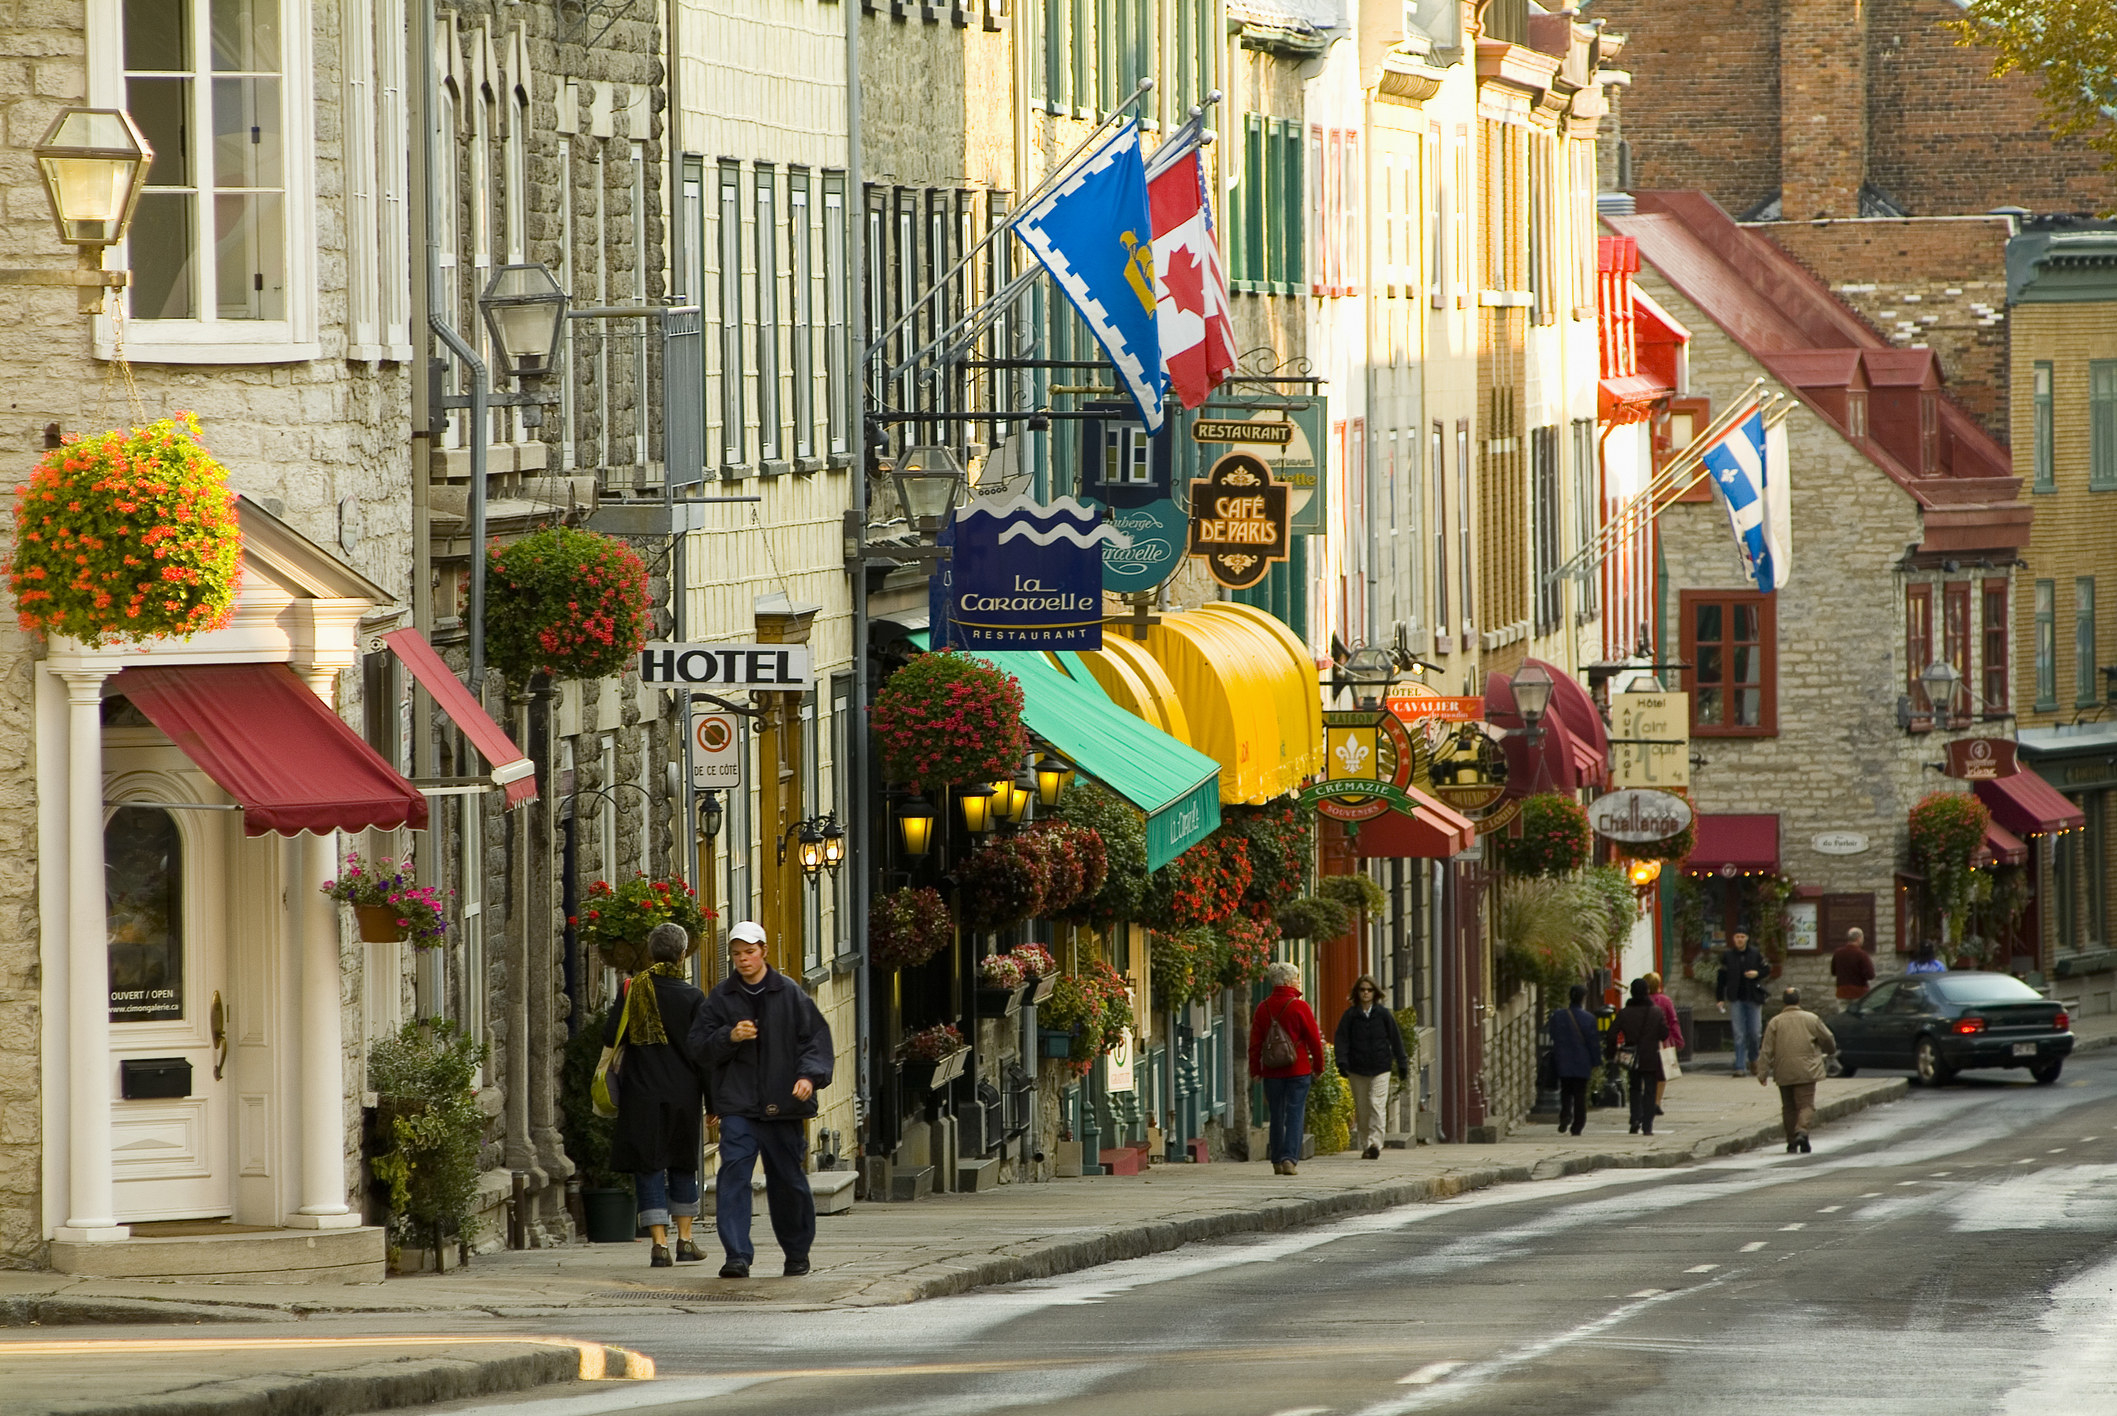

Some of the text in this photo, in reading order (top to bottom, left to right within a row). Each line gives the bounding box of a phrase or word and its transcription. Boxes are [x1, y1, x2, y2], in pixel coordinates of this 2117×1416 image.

[1198, 424, 1289, 440] RESTAURANT
[1215, 497, 1265, 519] CAFÉ
[1201, 521, 1277, 543] DE PARIS
[1015, 574, 1058, 592] La
[960, 592, 1094, 612] Caravelle
[972, 628, 1087, 640] RESTAURANT
[642, 649, 803, 684] HOTEL
[1393, 701, 1460, 712] CAVALIER
[1637, 698, 1666, 708] Hôtel
[1328, 712, 1374, 723] MAISON
[694, 766, 703, 775] DE
[707, 765, 717, 775] CE
[1315, 782, 1389, 795] CRÉMAZIE
[1599, 799, 1679, 836] Challenge
[111, 990, 143, 1000] OUVERT
[151, 989, 173, 999] OPEN
